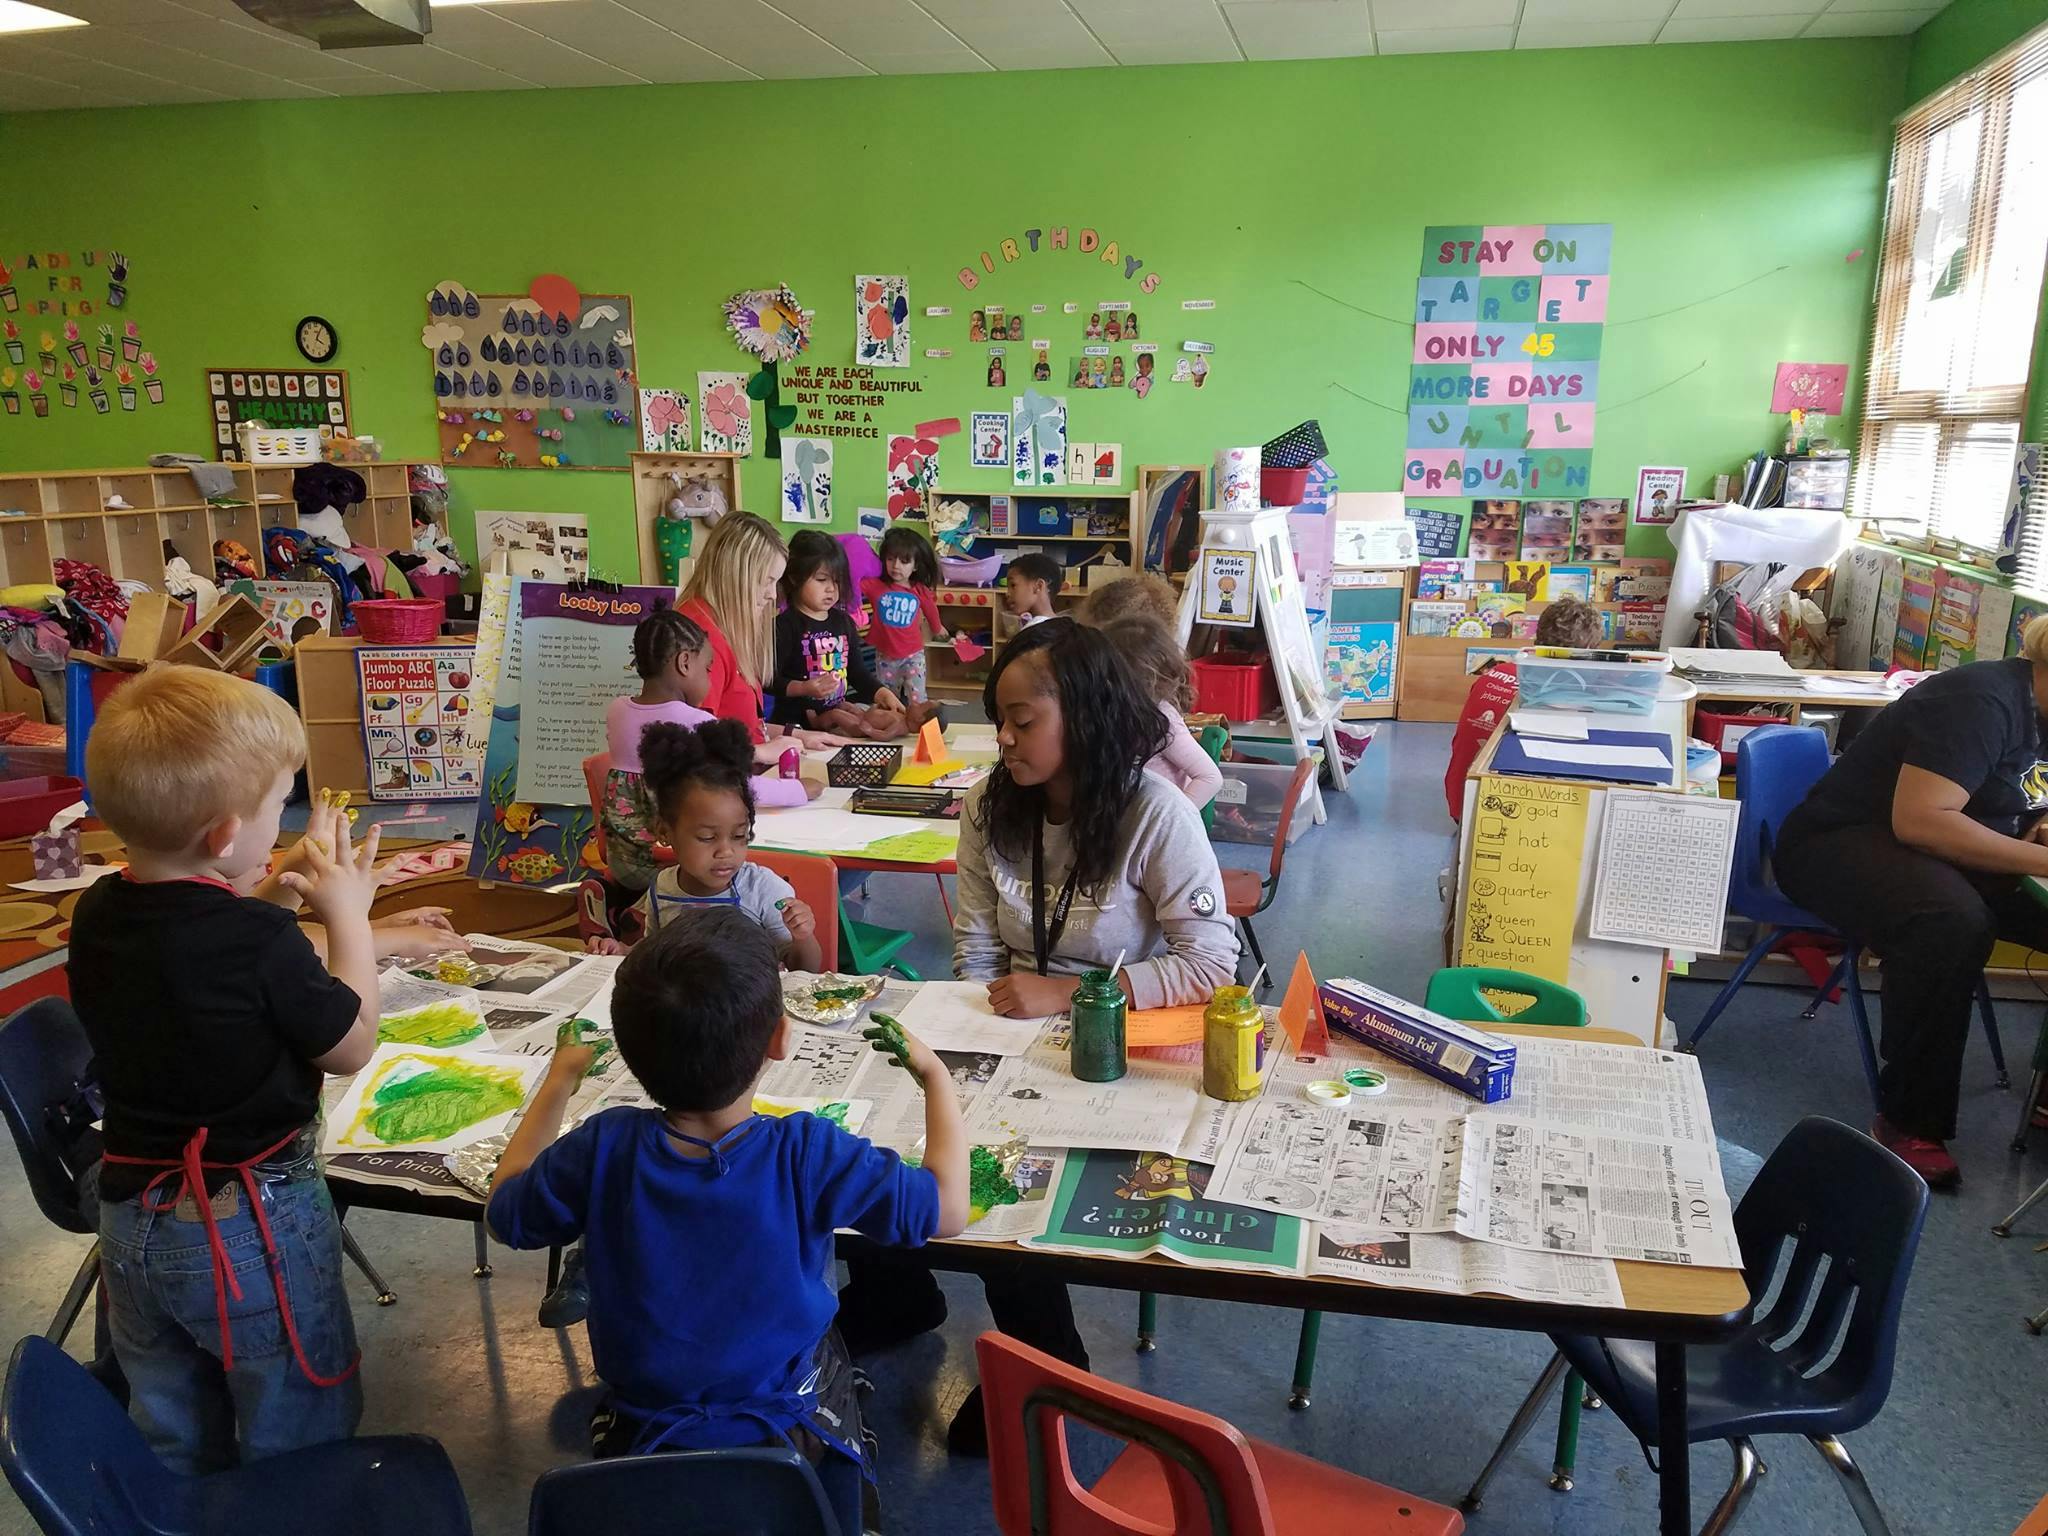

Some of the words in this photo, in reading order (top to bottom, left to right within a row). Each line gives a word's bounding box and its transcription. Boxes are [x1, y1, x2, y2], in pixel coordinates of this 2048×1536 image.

[957, 226, 1161, 294] BIRTHDAYS
[1438, 241, 1514, 264] STAY
[1533, 239, 1576, 263] ON
[433, 293, 479, 317] The
[1421, 279, 1592, 322] TARGET
[503, 310, 570, 336] Ants
[438, 347, 470, 366] Go
[482, 339, 622, 366] Marching
[1425, 335, 1504, 359] ONLY
[1521, 333, 1556, 357] 45
[794, 366, 812, 378] WE
[816, 367, 838, 378] ARE
[843, 368, 875, 380] EACH
[436, 374, 500, 397] Into
[512, 373, 618, 401] Spring
[781, 377, 824, 390] UNIQUE
[829, 379, 855, 391] AND
[860, 380, 923, 392] BEAUTIFUL
[1411, 376, 1490, 399] MORE
[1508, 374, 1583, 397] DAYS
[797, 393, 819, 404] BUT
[825, 394, 885, 407] TOGETHER
[238, 400, 326, 420] HEALTHY
[807, 409, 825, 420] WE
[834, 410, 856, 422] ARE
[863, 412, 872, 423] A
[794, 424, 880, 438] MASTERPIECE
[978, 419, 1004, 427] Cooking
[1427, 410, 1573, 449] UNTIL
[1075, 447, 1084, 464] h
[1070, 465, 1084, 481] H
[1407, 457, 1587, 490] GRADUATION
[1215, 557, 1244, 567] Music
[1212, 567, 1245, 577] Center
[559, 592, 608, 616] Looby
[611, 600, 642, 615] Loo
[886, 609, 913, 625] CUTE
[365, 662, 404, 675] Jumbo
[407, 662, 432, 674] ABC
[438, 661, 455, 670] Aa
[806, 653, 848, 672] HUGS
[367, 677, 395, 690] Floor
[399, 677, 435, 690] Puzzle
[1486, 682, 1512, 693] Children
[404, 695, 423, 706] Gg
[369, 714, 383, 724] Ff
[441, 713, 458, 723] Hh
[410, 746, 427, 755] Nn
[375, 761, 389, 770] Tt
[446, 759, 463, 768] Vv
[413, 774, 430, 783] Uu
[1489, 778, 1534, 798] March
[1537, 785, 1579, 802] Words
[1527, 805, 1558, 822] gold
[1519, 829, 1549, 848] hat
[1508, 857, 1537, 880] day
[1201, 894, 1211, 908] A
[1498, 882, 1552, 906] quarter
[1495, 913, 1536, 930] queen
[1502, 929, 1551, 947] QUEEN
[1476, 945, 1535, 965] question
[1324, 998, 1341, 1012] Value
[1361, 1012, 1415, 1046] Aluminum
[1415, 1035, 1438, 1055] Foil
[1670, 1201, 1683, 1225] enough
[1689, 1199, 1713, 1234] OUT
[1108, 1220, 1171, 1237] much
[1180, 1227, 1227, 1245] Too
